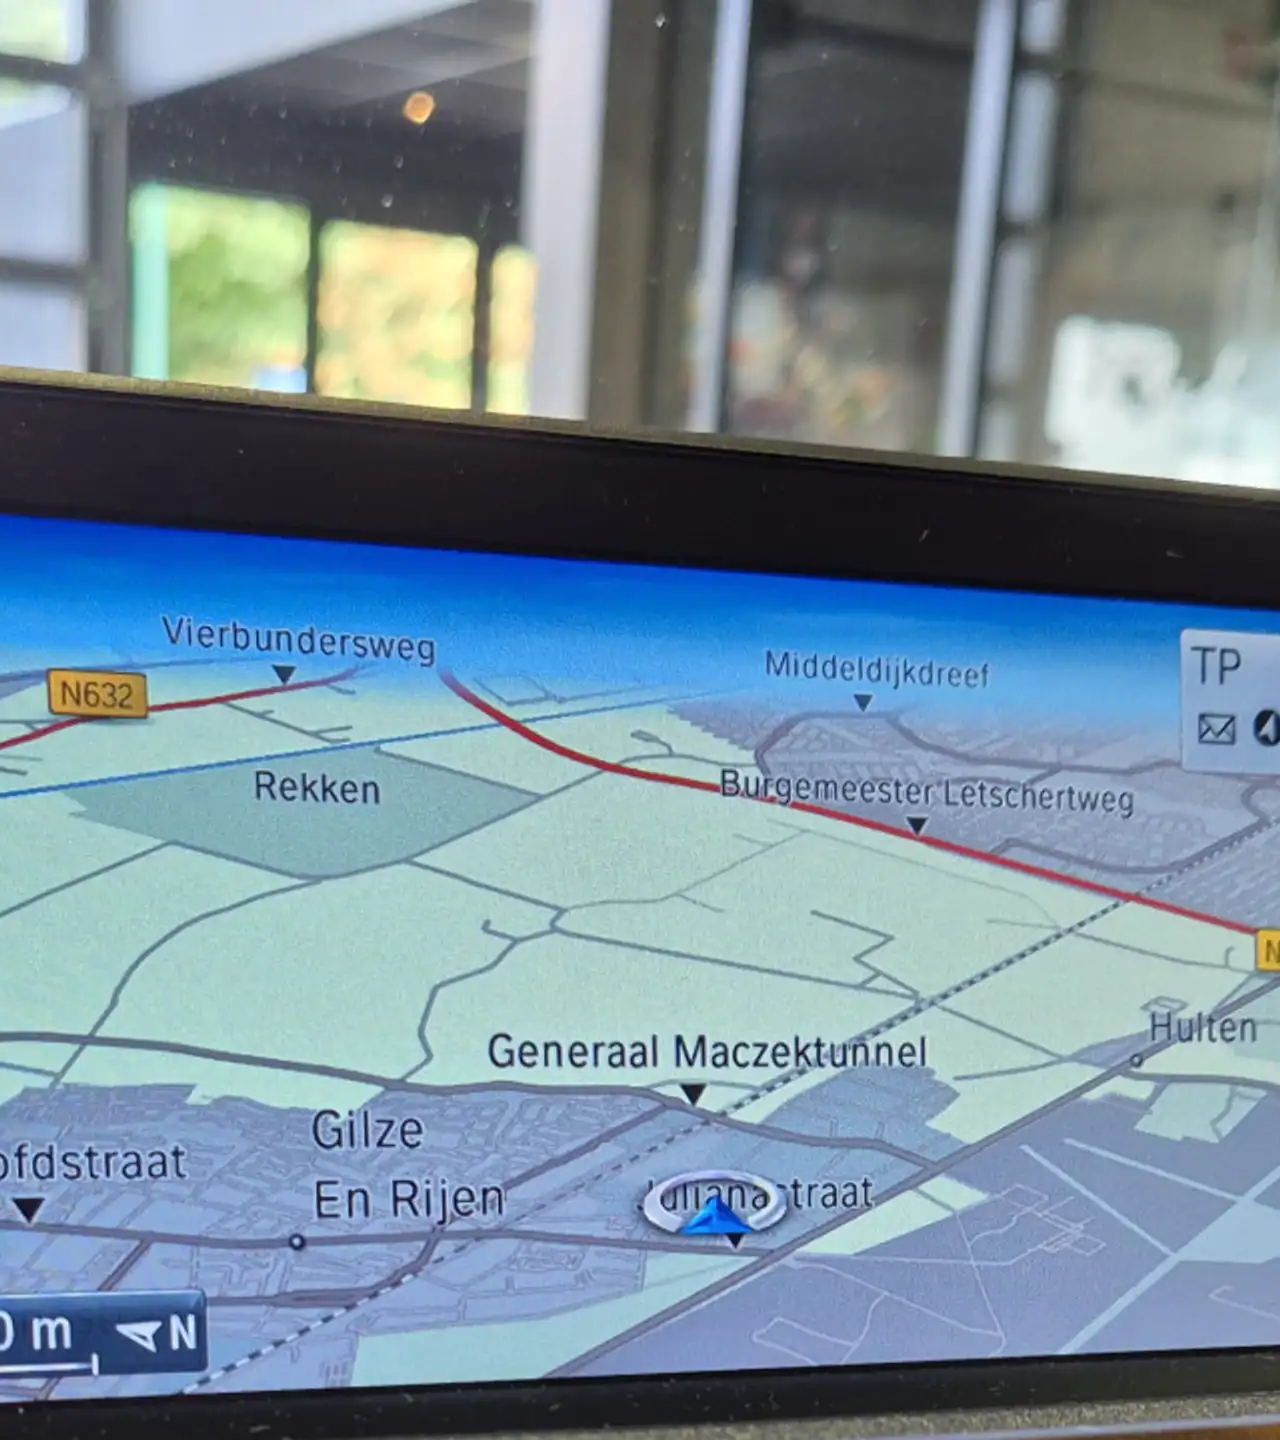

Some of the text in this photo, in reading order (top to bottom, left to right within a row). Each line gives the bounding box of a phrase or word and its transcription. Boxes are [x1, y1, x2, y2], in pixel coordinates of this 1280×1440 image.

[162, 615, 436, 667] Vierbundersweg
[766, 650, 990, 690] Middeldijkdreef
[1190, 646, 1242, 685] TP
[61, 680, 134, 709] N632
[254, 770, 380, 804] Rekken
[721, 769, 1135, 819] Burgemeester Letschertweg
[1150, 1011, 1257, 1044] Hulten
[488, 1032, 927, 1069] Generaal Maczektunnel
[312, 1108, 424, 1150] Gilze
[315, 1178, 504, 1226] En Rijen
[31, 1315, 72, 1351] m
[170, 1313, 198, 1352] N
